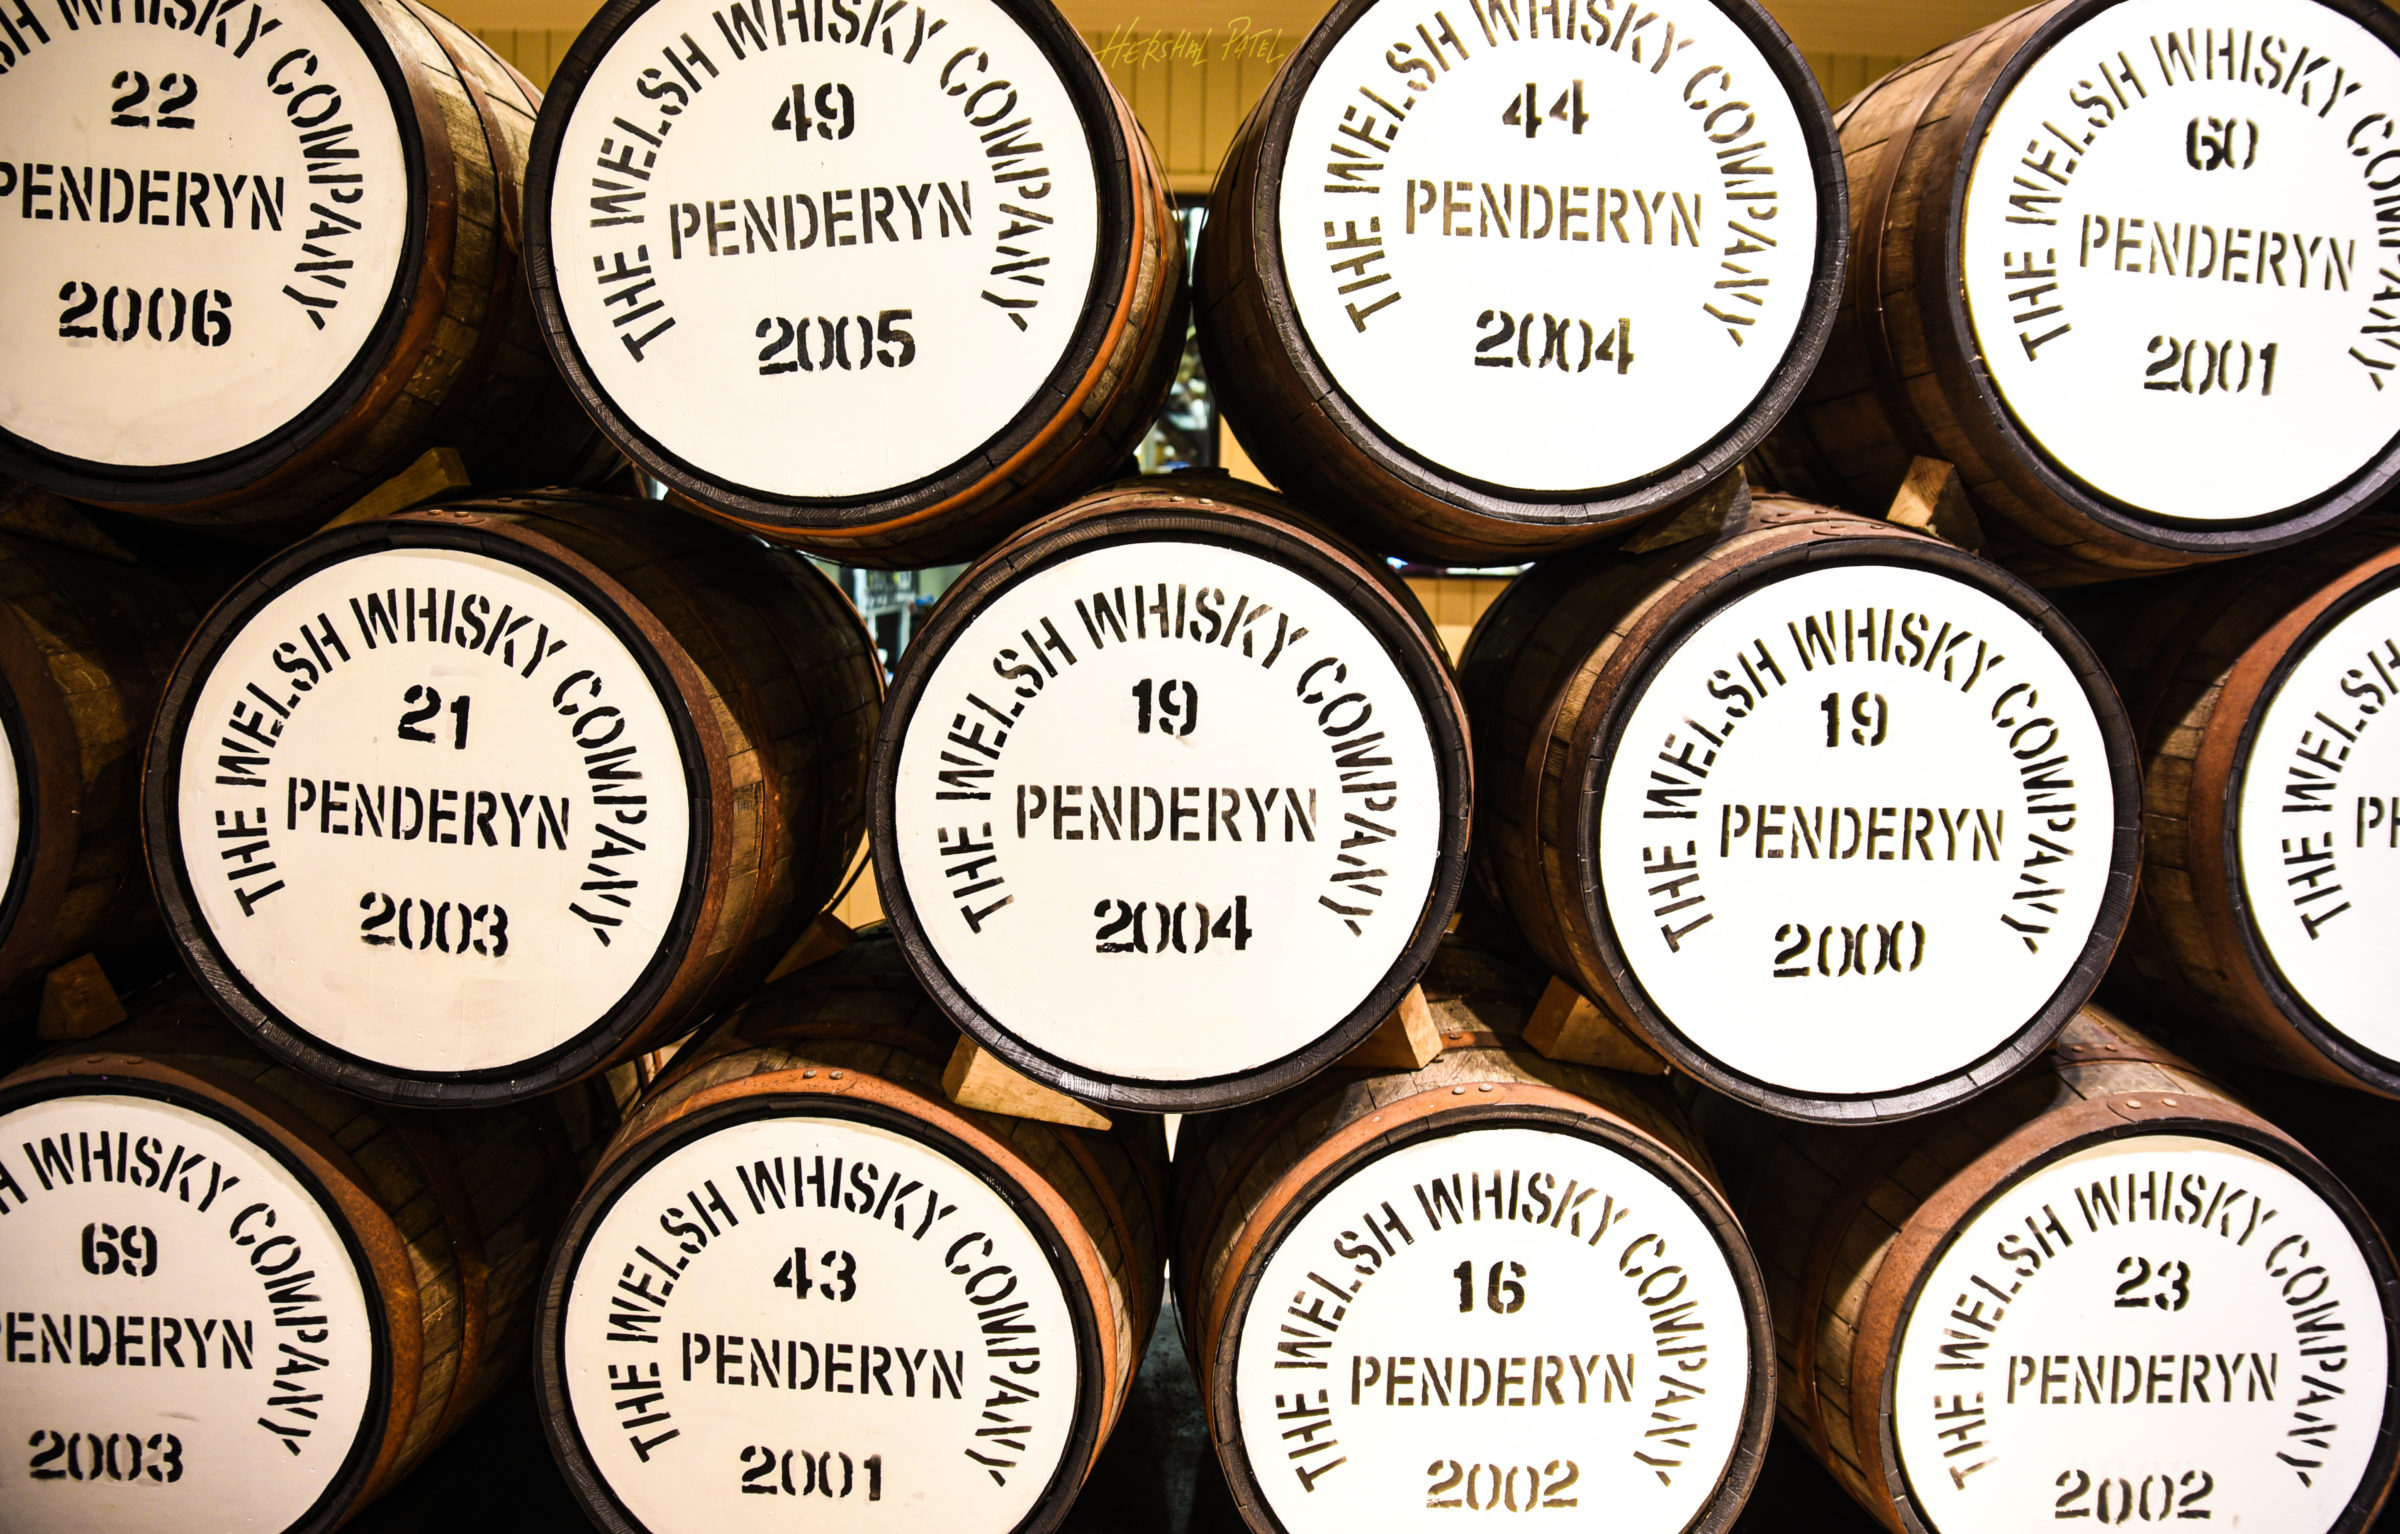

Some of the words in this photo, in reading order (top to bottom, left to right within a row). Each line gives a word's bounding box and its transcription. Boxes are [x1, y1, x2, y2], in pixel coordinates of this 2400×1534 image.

[711, 0, 948, 65] WHISKY
[1469, 0, 1695, 74] WHISKY
[110, 69, 199, 130] 22
[771, 82, 855, 142] 49
[1323, 11, 1473, 194] WELSH
[1502, 81, 1589, 139] 44
[2150, 28, 2362, 119] WHISKY
[590, 32, 719, 229] WELSH
[2005, 51, 2147, 228] WELSH
[2185, 117, 2258, 172] 60
[266, 48, 364, 331] COMPANY
[669, 180, 972, 260] PENDERYN
[937, 47, 1054, 333] COMPANY
[1406, 179, 1701, 248] PENDERYN
[1683, 66, 1777, 347] COMPANY
[1323, 216, 1402, 334] THE
[2079, 214, 2355, 292] PENDERYN
[58, 280, 233, 348] 2006
[592, 244, 677, 363] THE
[755, 309, 916, 376] 2005
[1474, 309, 1634, 375] 2004
[2003, 248, 2071, 362] THE
[2143, 335, 2277, 396] 2001
[348, 587, 568, 680] WHISKY
[1074, 582, 1309, 670] WHISKY
[1787, 607, 2005, 693] WHISKY
[214, 612, 352, 792] WELSH
[397, 684, 471, 751] 21
[935, 616, 1083, 801] WELSH
[1131, 677, 1199, 737] 19
[1642, 638, 1787, 821] WELSH
[1820, 691, 1888, 748] 19
[287, 776, 570, 851] PENDERYN
[551, 669, 648, 948] COMPANY
[1016, 784, 1317, 843] PENDERYN
[1295, 657, 1397, 937] COMPANY
[1720, 804, 2003, 862] PENDERYN
[1991, 682, 2076, 954] COMPANY
[214, 806, 286, 918] THE
[937, 821, 1013, 935] THE
[1642, 840, 1714, 954] THE
[2281, 831, 2351, 941] THE
[359, 891, 509, 958] 2003
[1093, 895, 1253, 954] 2004
[1773, 920, 1925, 978] 2000
[735, 1155, 958, 1241] WHISKY
[1413, 1170, 1625, 1247] WHISKY
[2074, 1170, 2277, 1246] WHISKY
[81, 1222, 158, 1278] 69
[606, 1179, 744, 1346] WELSH
[772, 1246, 857, 1303] 43
[1274, 1201, 1416, 1373] WELSH
[1453, 1260, 1527, 1314] 16
[1935, 1204, 2073, 1375] WELSH
[2114, 1256, 2191, 1312] 23
[22, 1130, 241, 1213] WHISKY
[227, 1202, 330, 1457] COMPANY
[0, 1311, 254, 1370] ENDERYN
[682, 1332, 964, 1400] PENDERYN
[944, 1231, 1041, 1488] COMPANY
[1351, 1353, 1634, 1407] PENDERYN
[1617, 1233, 1707, 1487] COMPANY
[2007, 1352, 2278, 1405] PENDERYN
[2265, 1234, 2348, 1488] COMPANY
[607, 1361, 681, 1464] THE
[1275, 1389, 1344, 1493] THE
[1934, 1391, 1999, 1491] THE
[28, 1429, 185, 1484] 2003
[739, 1444, 882, 1502] 2001
[1427, 1460, 1579, 1512] 2002
[2054, 1469, 2214, 1525] 2002
